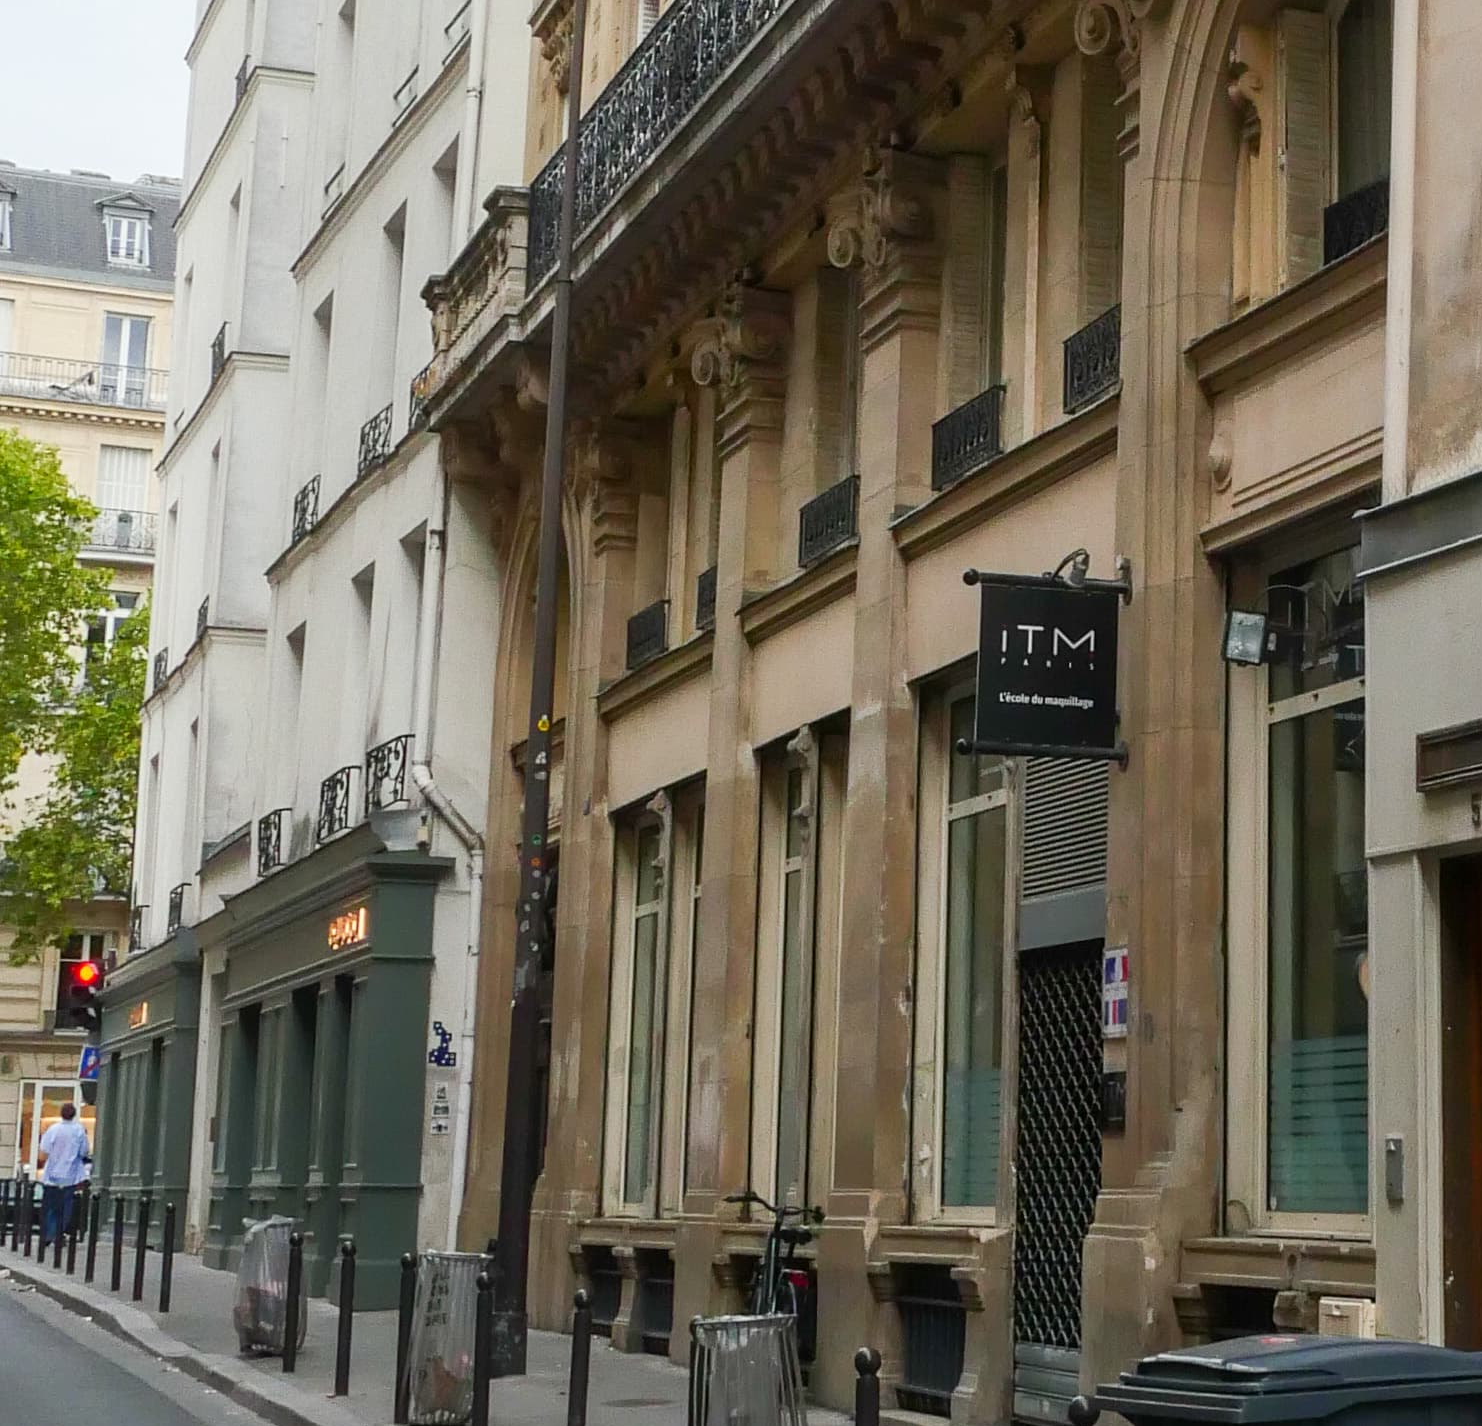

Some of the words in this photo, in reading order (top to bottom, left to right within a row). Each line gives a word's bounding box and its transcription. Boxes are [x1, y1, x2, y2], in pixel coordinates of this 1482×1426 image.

[1001, 624, 1096, 656] ITM
[1000, 656, 1096, 671] PARIS
[999, 691, 1030, 704] L'école
[1031, 693, 1043, 705] du
[1044, 695, 1094, 710] maquillage
